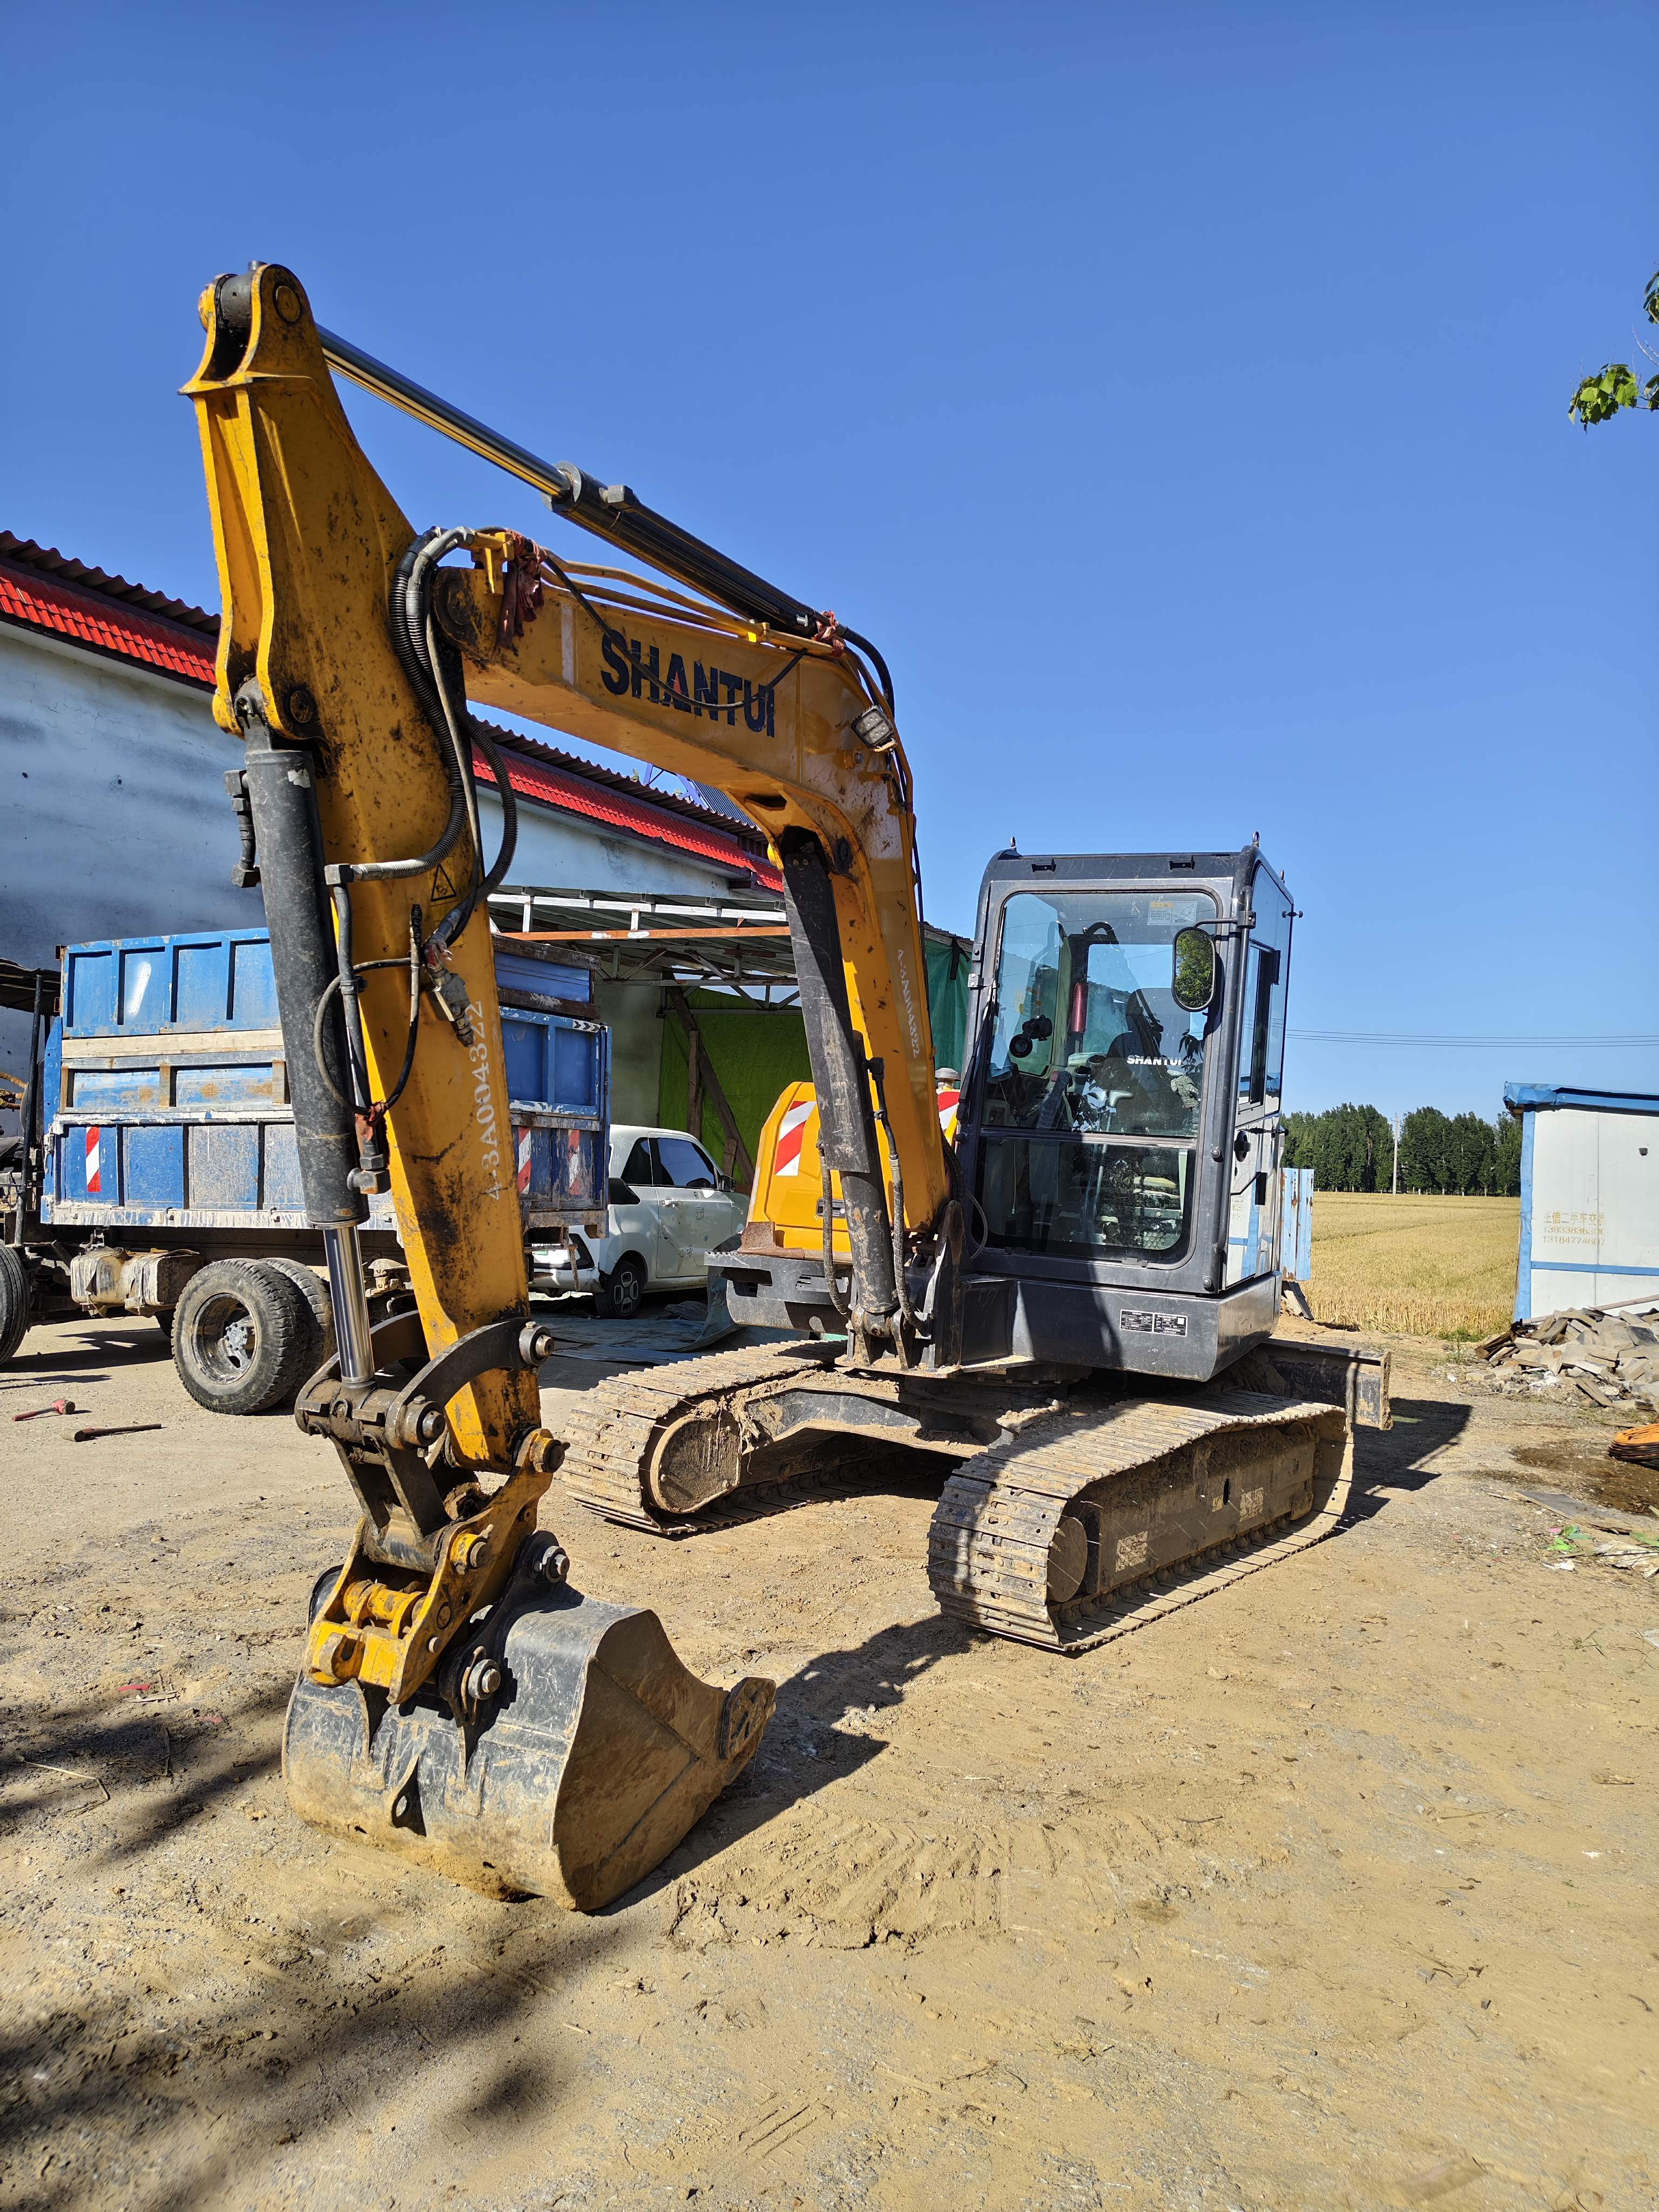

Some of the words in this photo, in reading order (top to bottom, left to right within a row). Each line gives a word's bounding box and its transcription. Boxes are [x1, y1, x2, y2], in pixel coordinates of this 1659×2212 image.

[601, 630, 775, 738] SHANTUI
[898, 949, 920, 1058] 4-3A004322
[466, 1000, 502, 1201] 4-3A004322
[1127, 1054, 1182, 1066] SHANTUI
